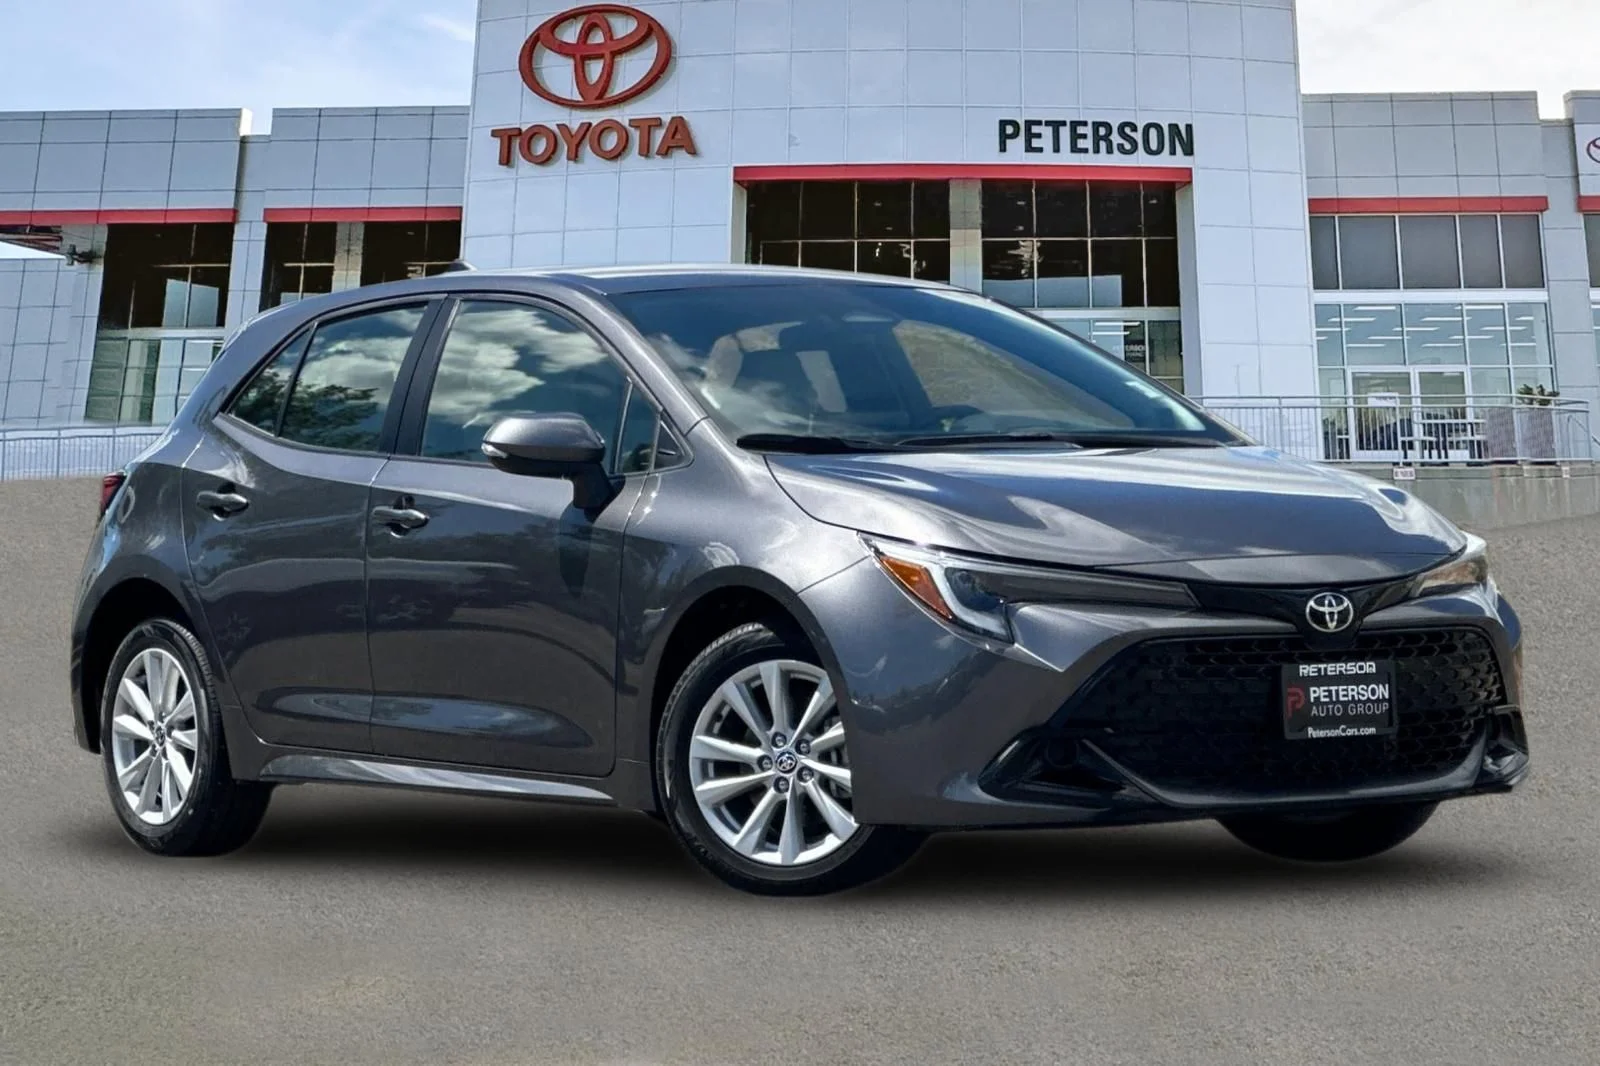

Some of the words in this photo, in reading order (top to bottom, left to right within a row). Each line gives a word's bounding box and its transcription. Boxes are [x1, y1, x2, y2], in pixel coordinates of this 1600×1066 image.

[491, 116, 697, 166] TOYOTA
[999, 119, 1194, 156] PETERSON
[1309, 684, 1389, 703] PETERSON
[1311, 704, 1343, 717] AUTO
[1348, 702, 1389, 716] GROUP
[1307, 725, 1377, 738] PetersonCars.com
